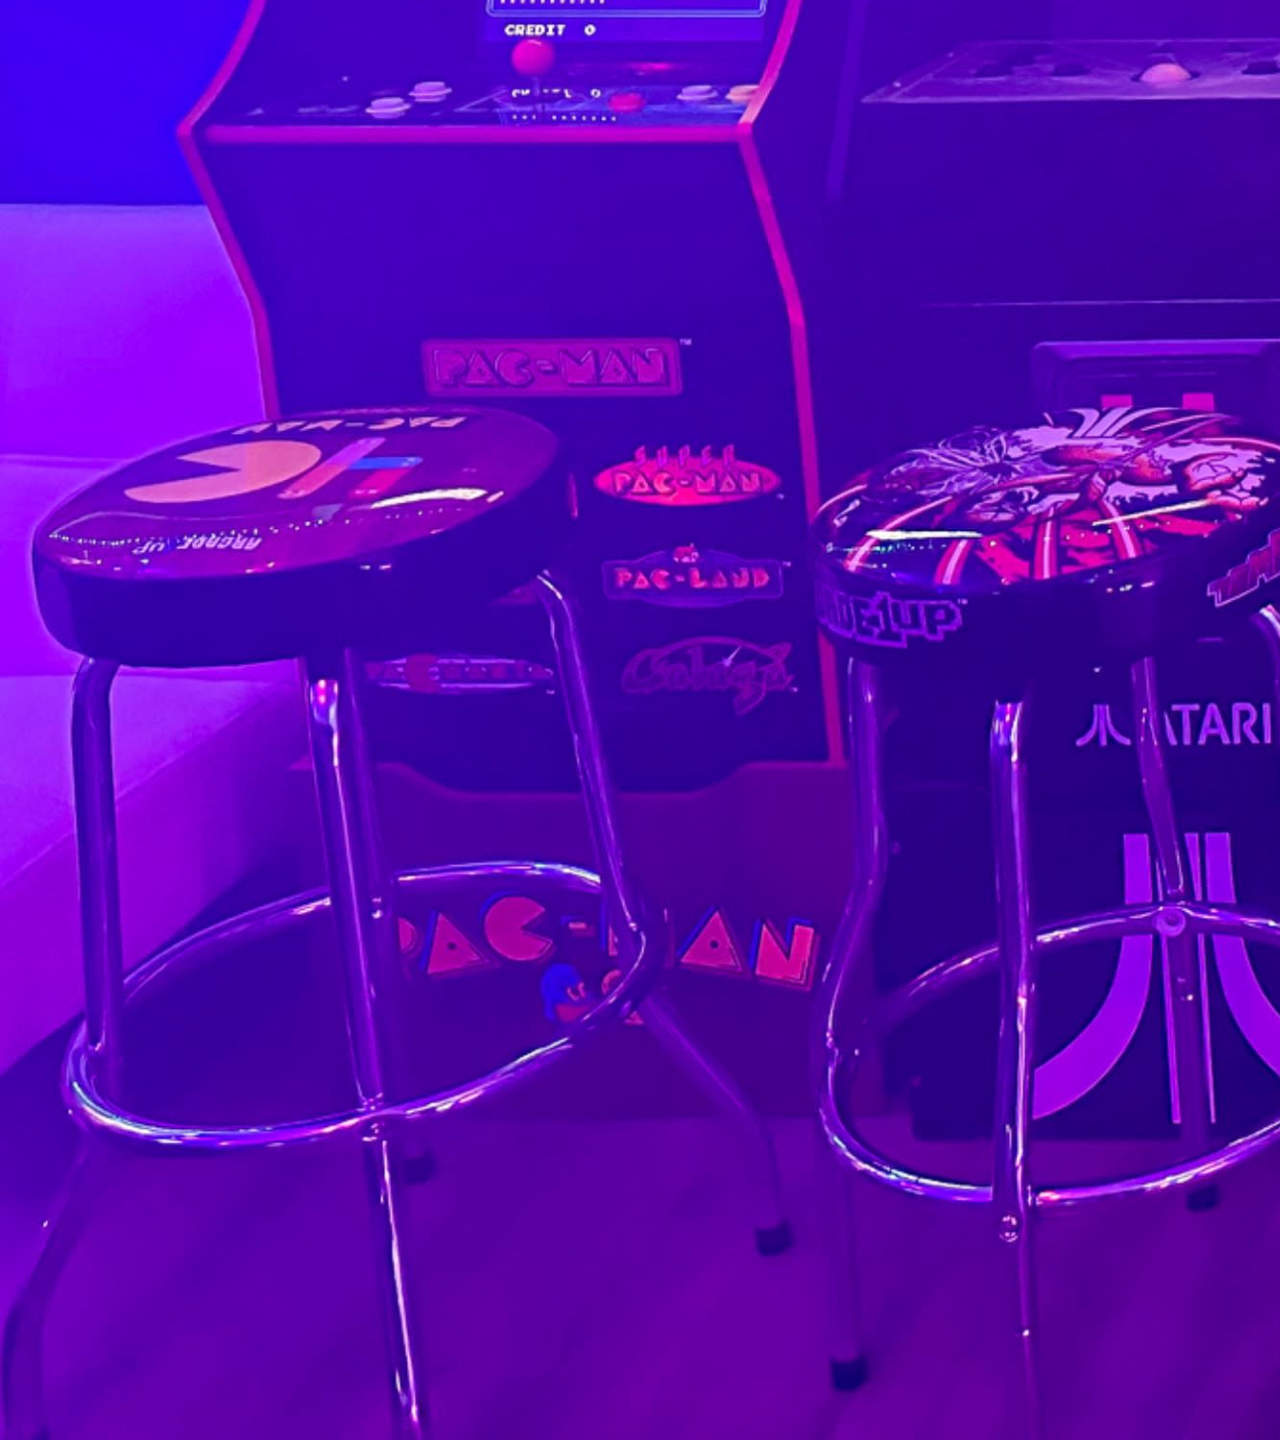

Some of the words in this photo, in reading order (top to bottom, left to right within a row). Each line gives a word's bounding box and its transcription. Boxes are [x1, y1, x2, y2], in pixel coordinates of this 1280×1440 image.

[504, 24, 566, 36] CREDIT
[433, 348, 669, 387] PAC-MAN
[614, 472, 761, 494] PAC-MAN
[614, 567, 770, 591] PAC-LAND
